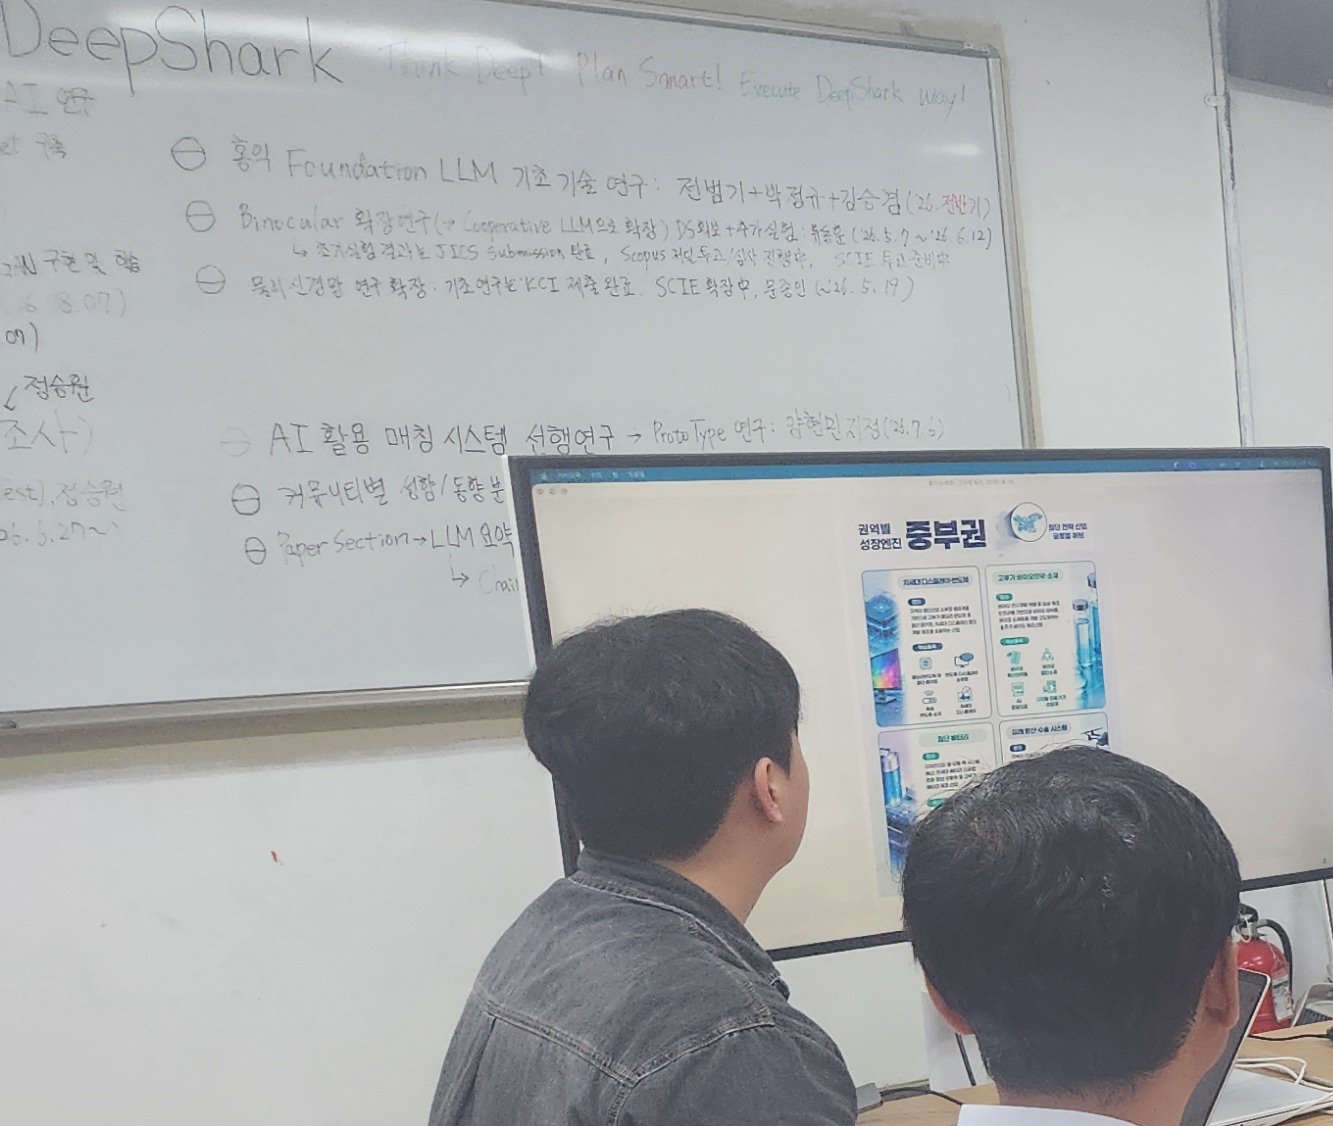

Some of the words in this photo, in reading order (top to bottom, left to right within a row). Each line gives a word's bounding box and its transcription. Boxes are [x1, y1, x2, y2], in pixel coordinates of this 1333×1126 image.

[0, 0, 343, 97] DeepShark
[577, 51, 627, 87] Plan
[639, 56, 722, 91] Smart!
[286, 148, 428, 182] Foundation
[440, 157, 499, 185] LLM
[513, 164, 551, 190] 기초
[557, 170, 597, 197] 기술
[239, 202, 345, 232] Binocular
[270, 422, 313, 455] AI
[321, 422, 369, 456] 활용
[385, 423, 433, 453] 매칭
[444, 424, 507, 456] 시스템
[860, 537, 902, 550] 성장엔진
[905, 519, 987, 551] 중부권
